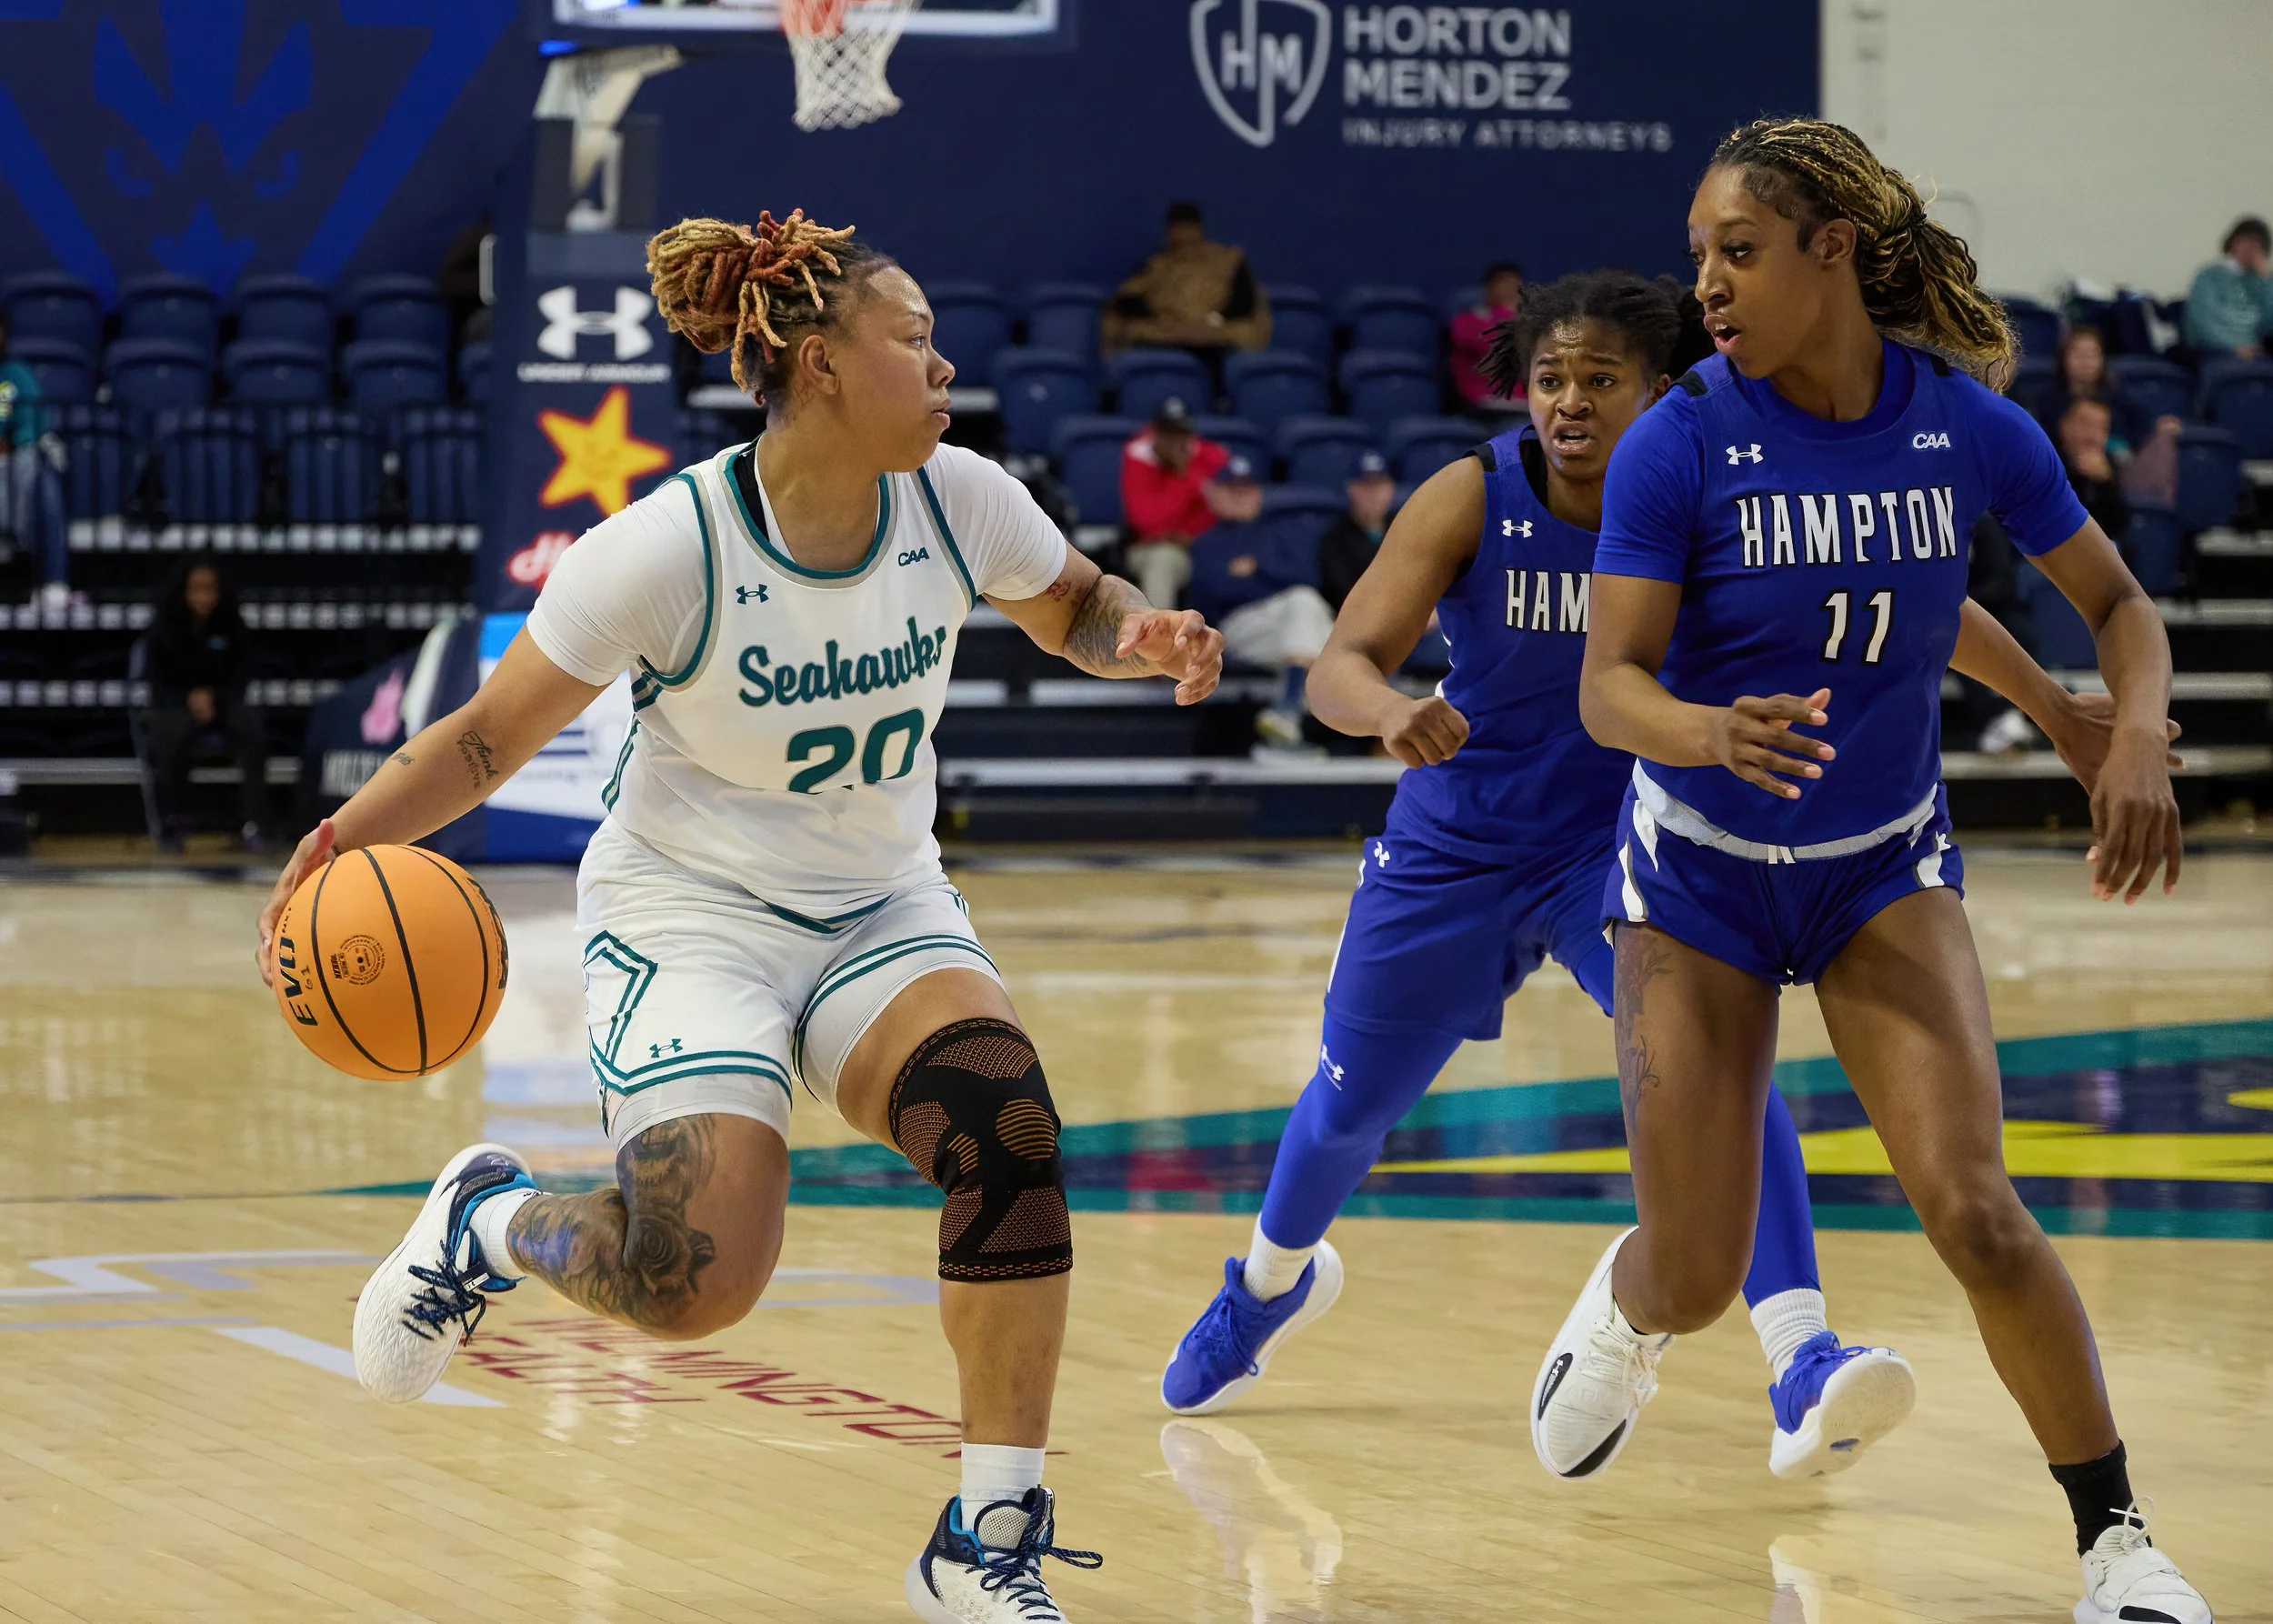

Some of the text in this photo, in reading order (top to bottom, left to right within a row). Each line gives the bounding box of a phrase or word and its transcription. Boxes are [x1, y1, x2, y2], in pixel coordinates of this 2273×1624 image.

[1343, 7, 1571, 57] HORTON
[1343, 60, 1571, 110] MENDEZ
[1342, 118, 1673, 153] INJURY ATTORNEYS
[1912, 432, 1952, 450] CAA
[897, 546, 930, 567] CAA
[1737, 486, 1958, 567] HAMPTON
[1822, 589, 1893, 665] 11
[738, 616, 946, 707] Seahawks
[785, 707, 925, 795] 20
[278, 937, 318, 1027] EVO
